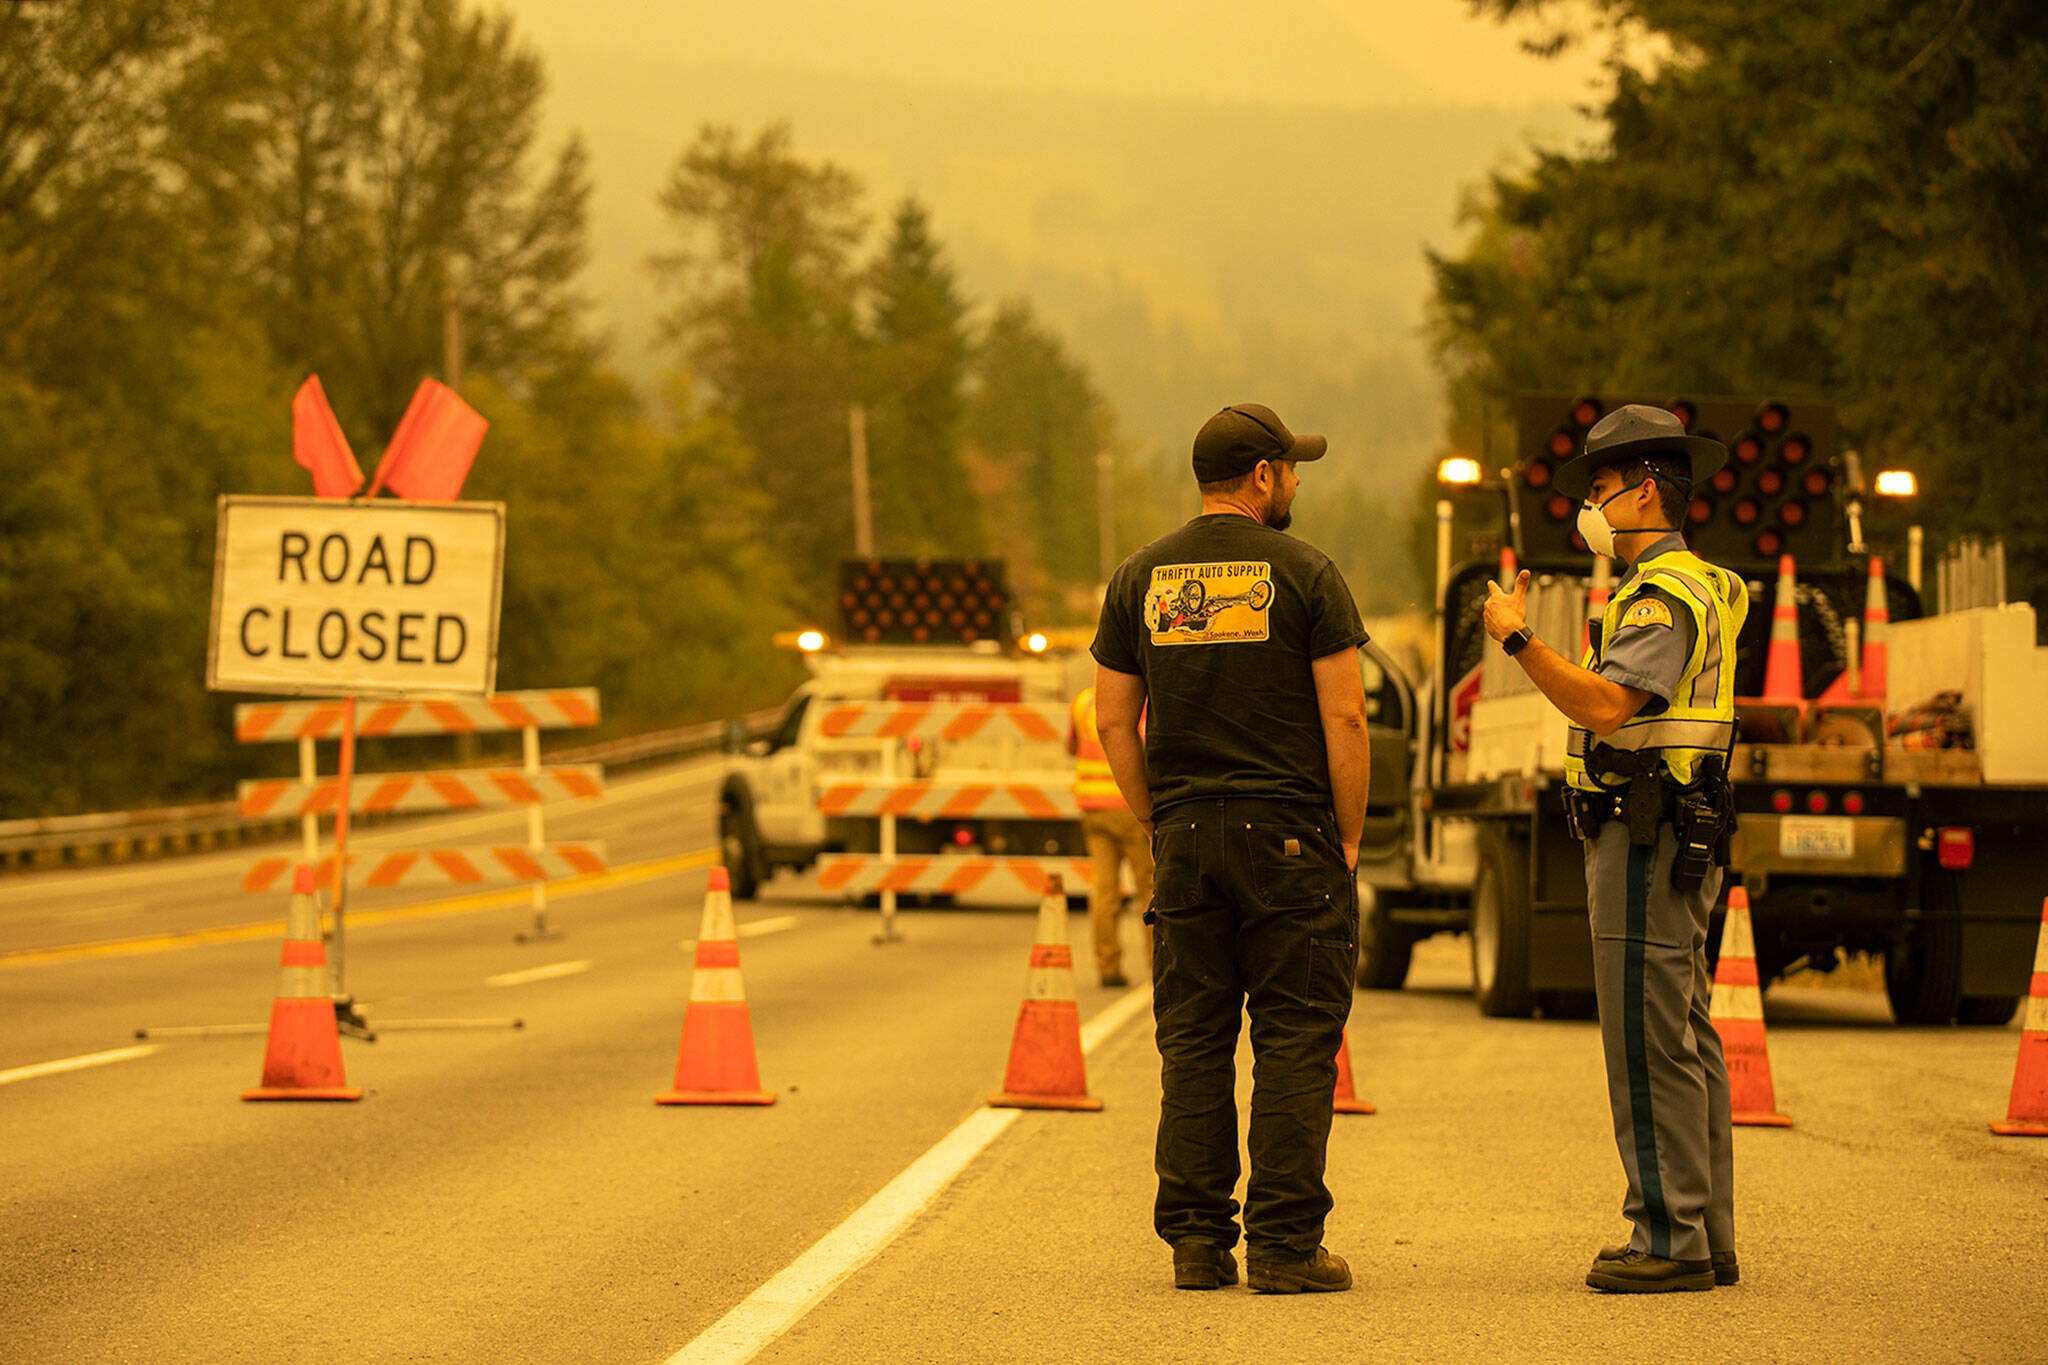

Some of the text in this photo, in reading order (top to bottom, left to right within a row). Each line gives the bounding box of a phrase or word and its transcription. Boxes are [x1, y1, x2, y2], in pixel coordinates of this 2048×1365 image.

[279, 532, 436, 585] ROAD
[1157, 565, 1264, 581] THRIFTY AUTO SUPPLY
[240, 607, 467, 664] CLOSED
